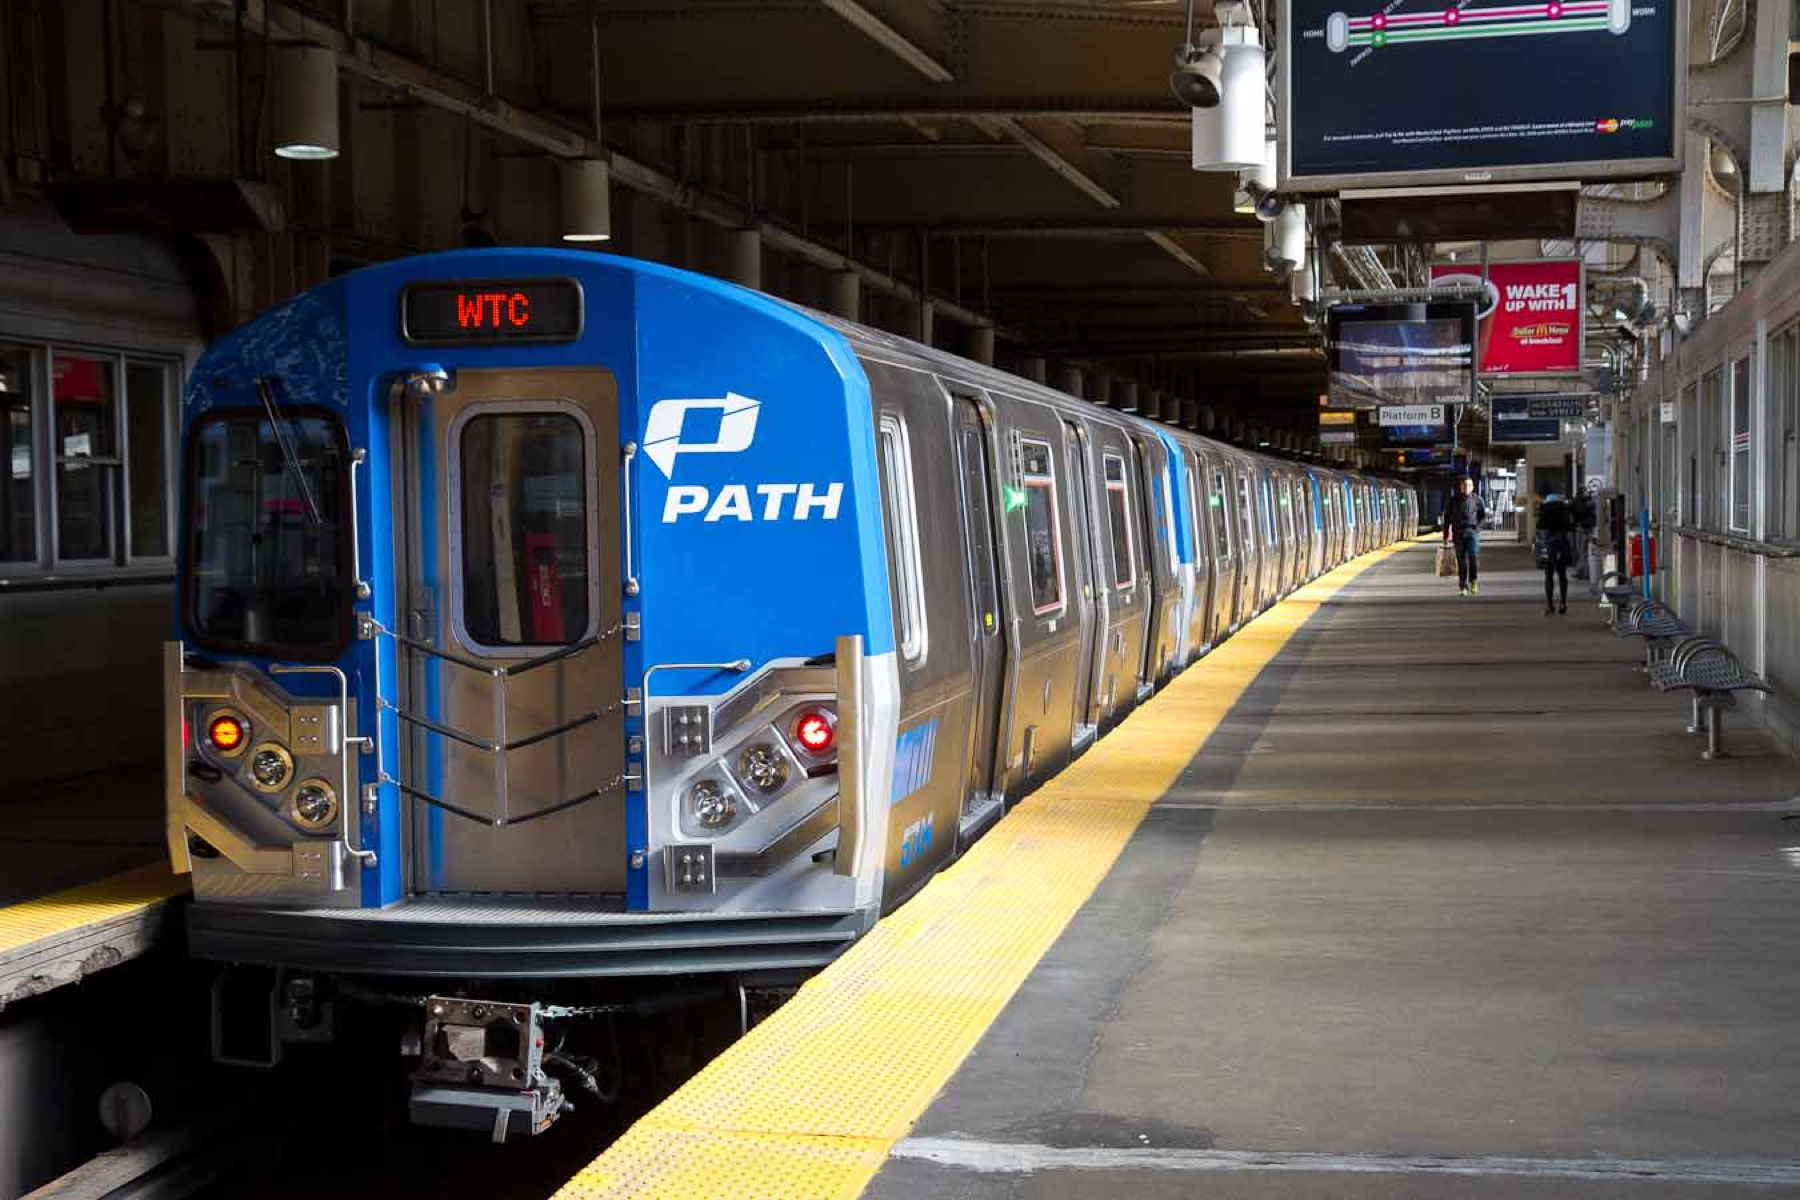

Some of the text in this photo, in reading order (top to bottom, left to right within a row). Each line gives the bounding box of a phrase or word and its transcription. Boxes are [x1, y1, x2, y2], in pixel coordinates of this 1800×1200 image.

[1505, 283, 1576, 312] UP WITH 1
[1506, 284, 1560, 300] WAKE
[458, 293, 529, 327] WTC
[1382, 407, 1441, 420] Platform B
[662, 482, 844, 524] PATH
